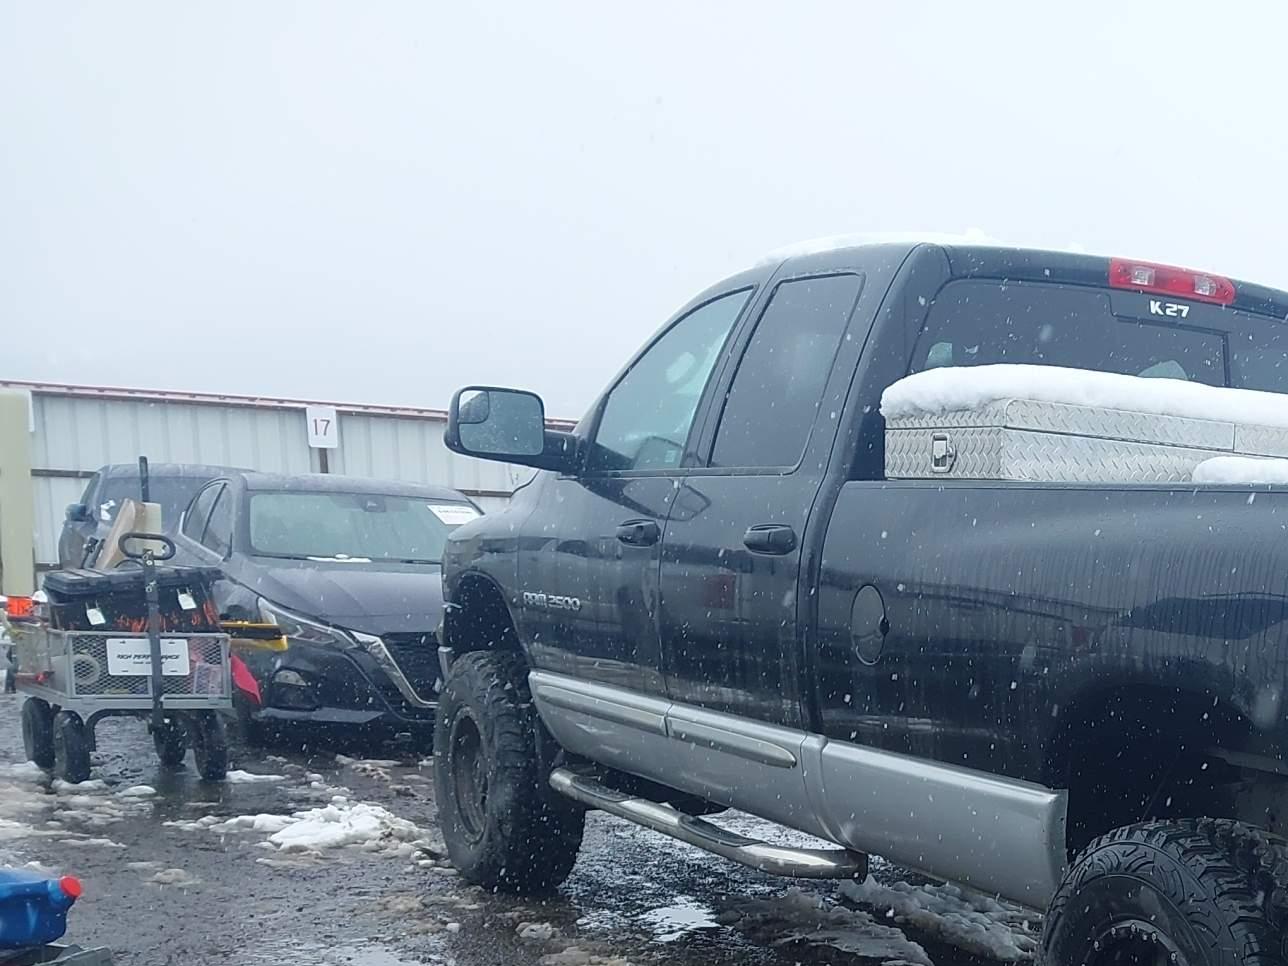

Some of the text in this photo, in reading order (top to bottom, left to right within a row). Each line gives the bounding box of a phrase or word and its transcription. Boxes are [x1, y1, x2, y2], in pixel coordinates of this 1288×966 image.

[314, 419, 330, 436] 17
[523, 592, 581, 611] RAM 2500
